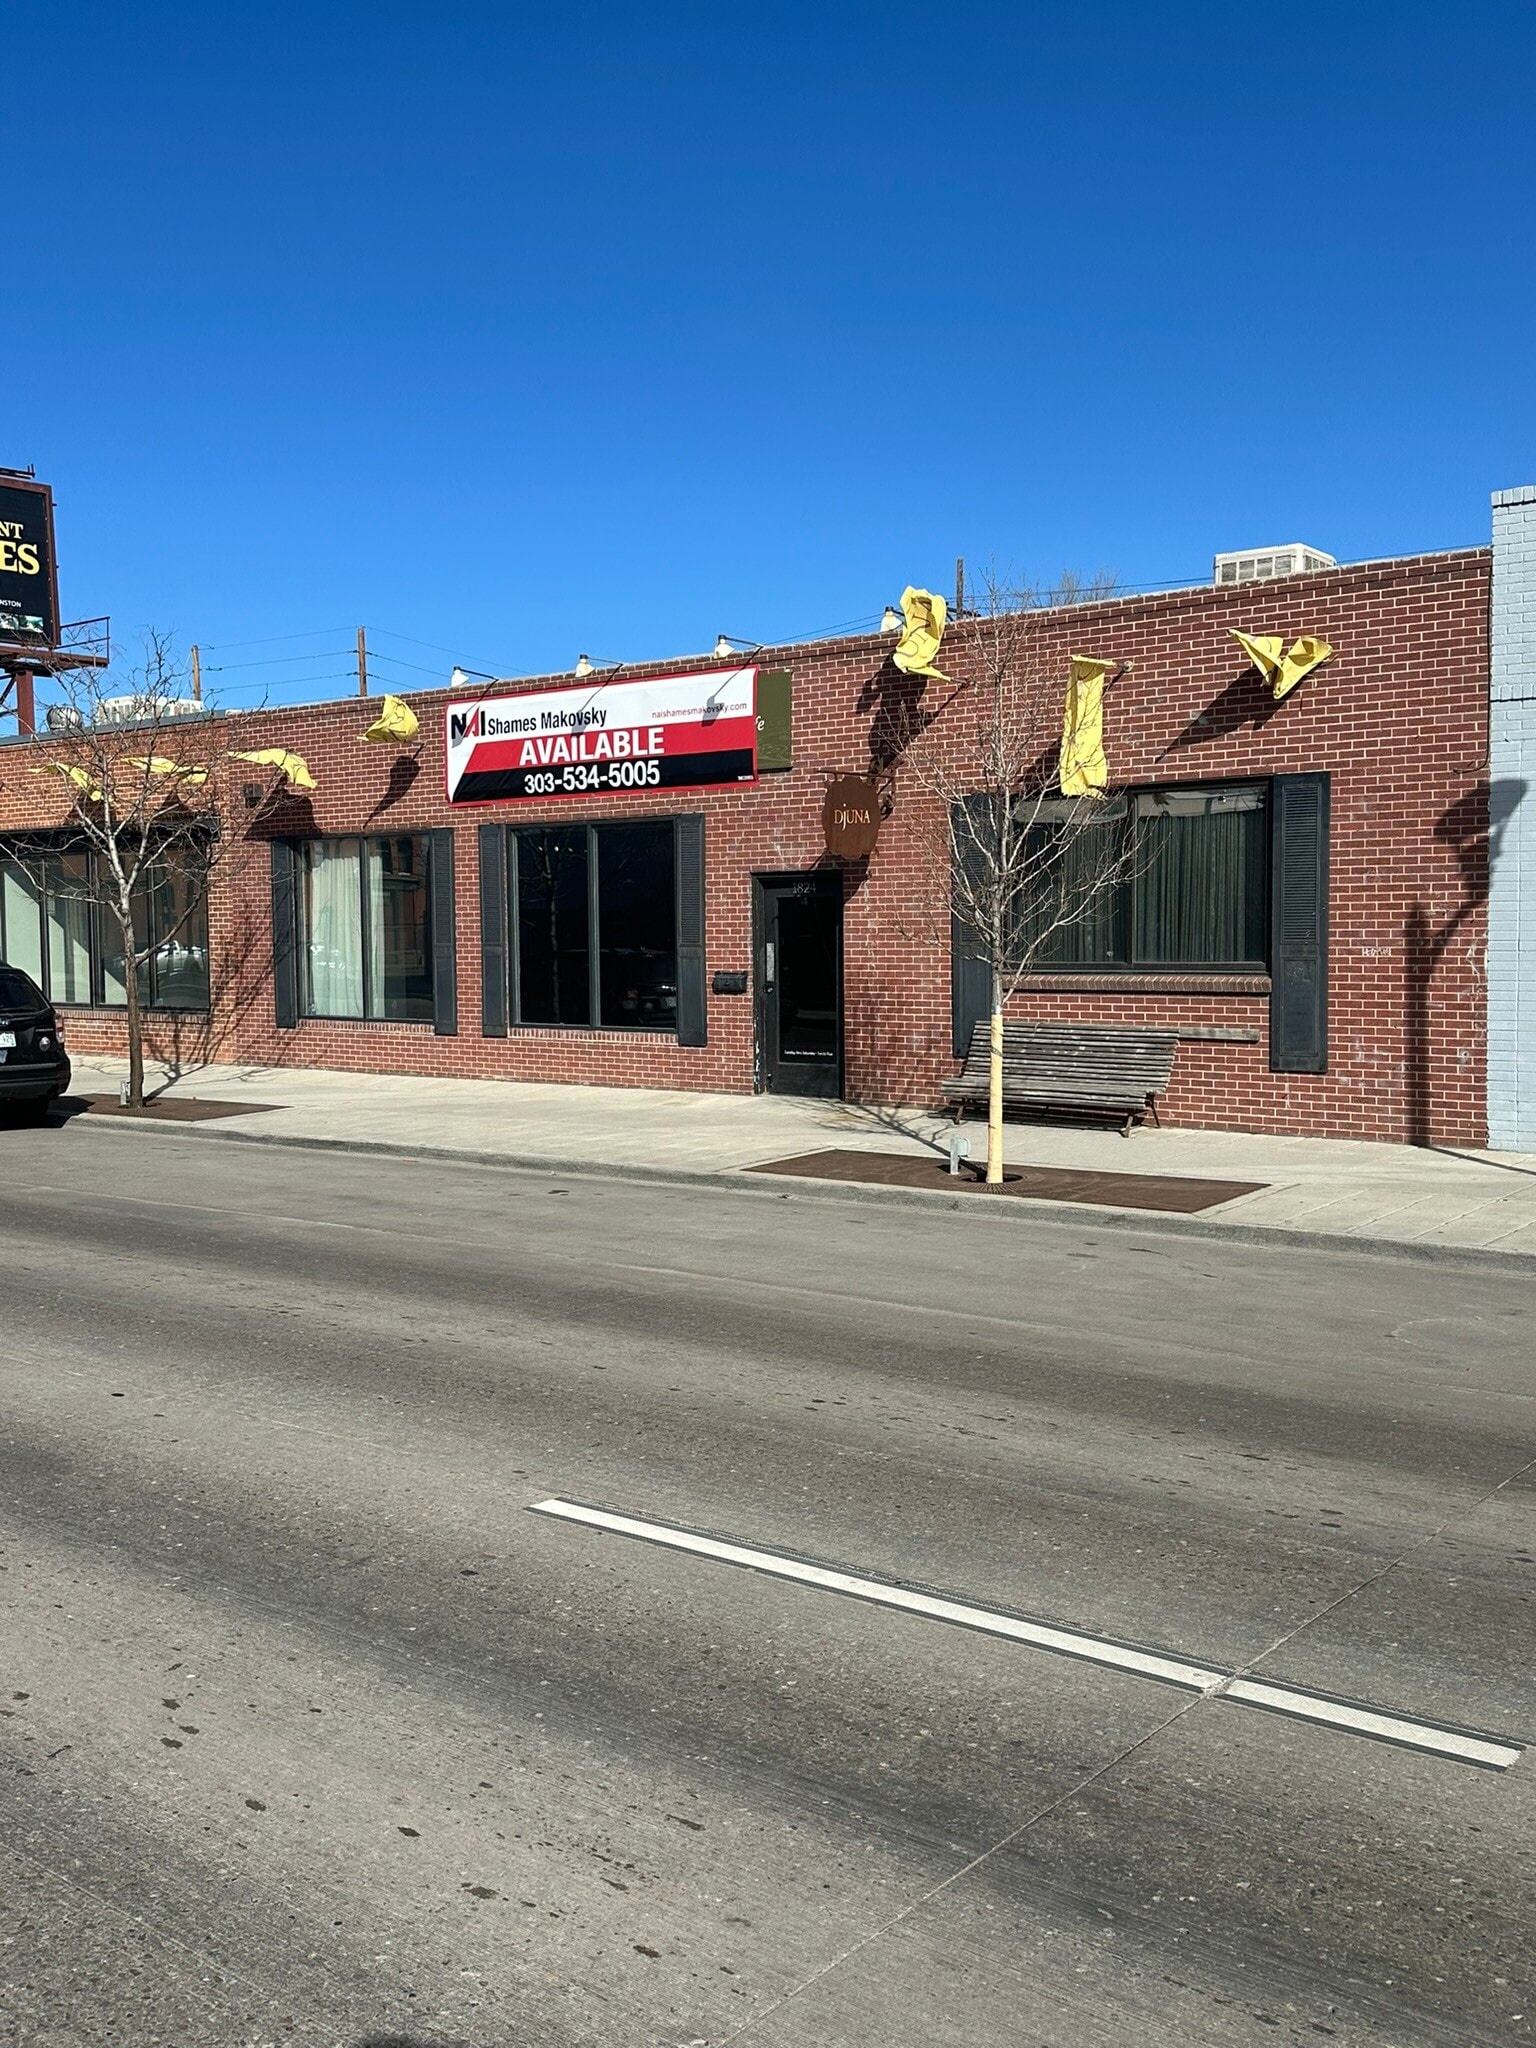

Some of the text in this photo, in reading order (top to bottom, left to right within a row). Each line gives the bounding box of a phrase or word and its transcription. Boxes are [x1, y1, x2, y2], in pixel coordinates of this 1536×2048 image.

[451, 706, 607, 739] NAI Shames Makovsky
[652, 702, 747, 718] naishamesmakovsky.com
[519, 727, 665, 766] AVAILABLE
[524, 760, 661, 794] 303-534-5005
[792, 882, 817, 894] 1824
